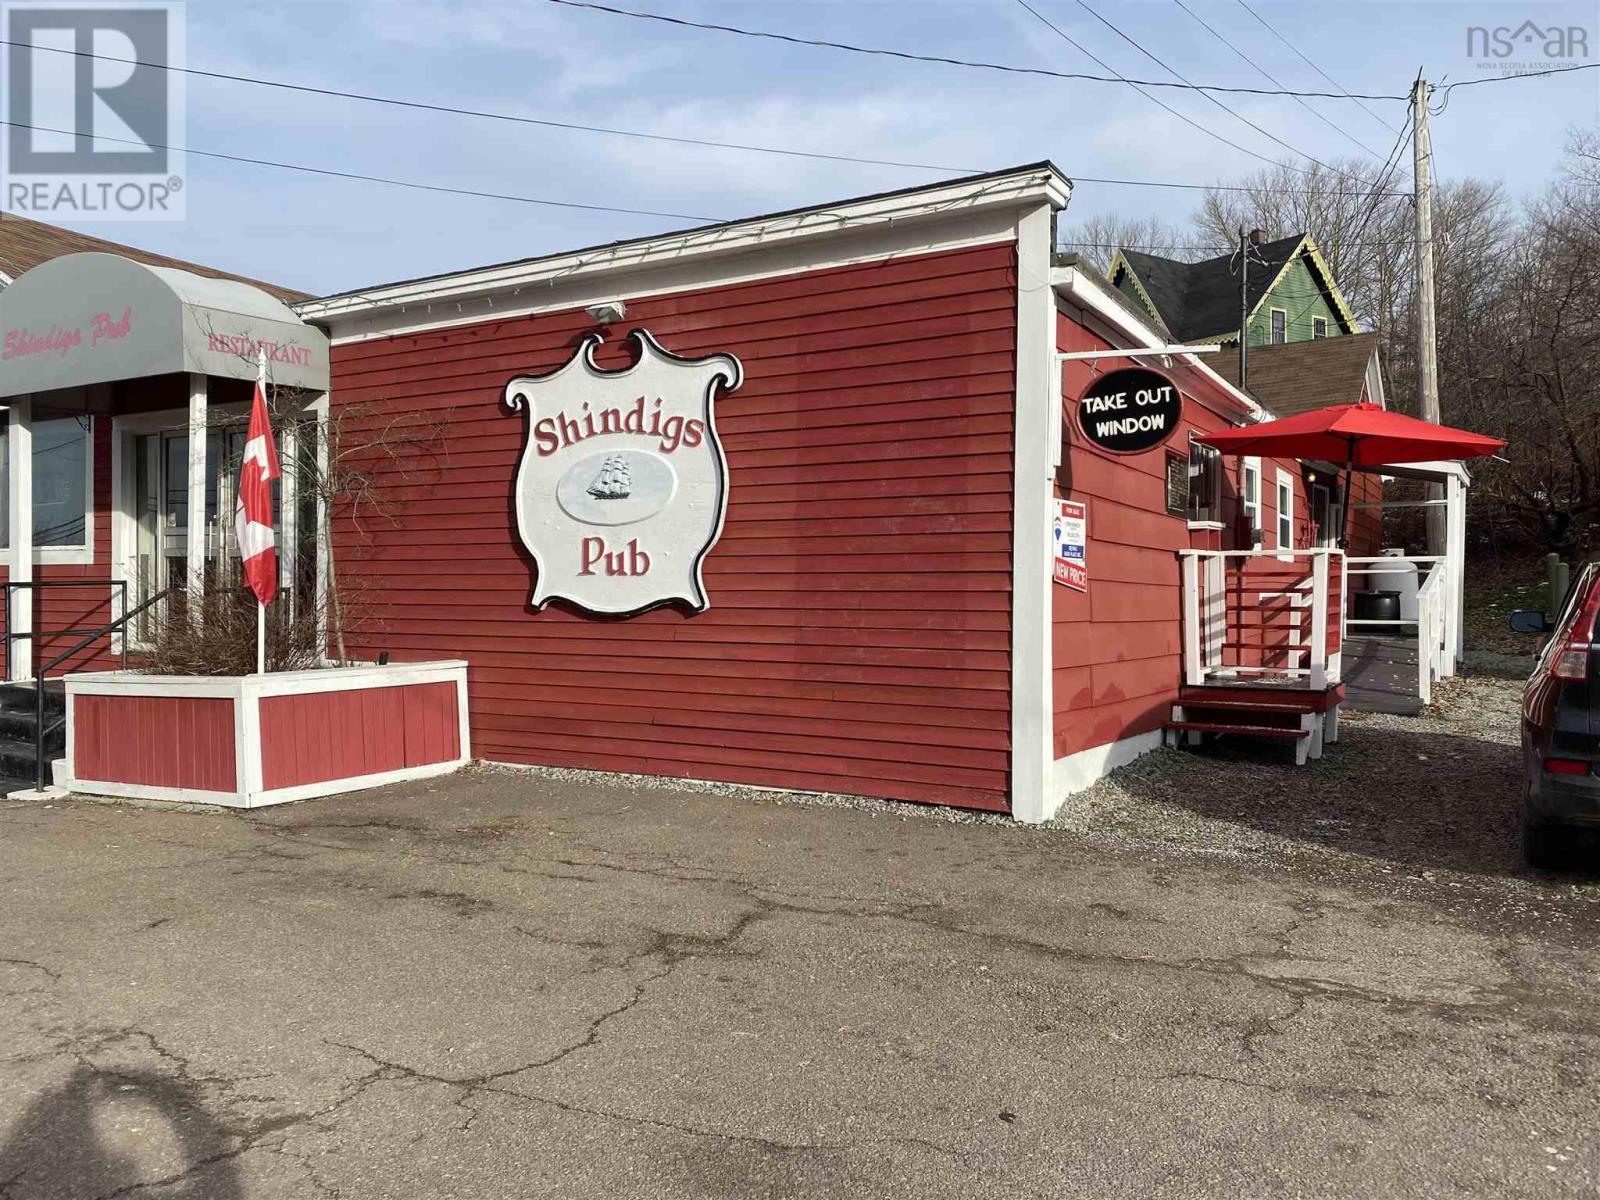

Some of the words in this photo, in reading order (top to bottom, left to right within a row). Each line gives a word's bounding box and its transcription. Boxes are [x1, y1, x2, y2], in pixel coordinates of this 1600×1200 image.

[90, 305, 132, 349] Pub
[1082, 392, 1128, 414] TAKE
[1135, 386, 1173, 406] OUT
[533, 395, 705, 457] Shindigs
[1096, 414, 1165, 438] WINDOW
[576, 536, 651, 577] Pub
[1055, 561, 1070, 581] NEW
[1069, 566, 1086, 587] PRICE
